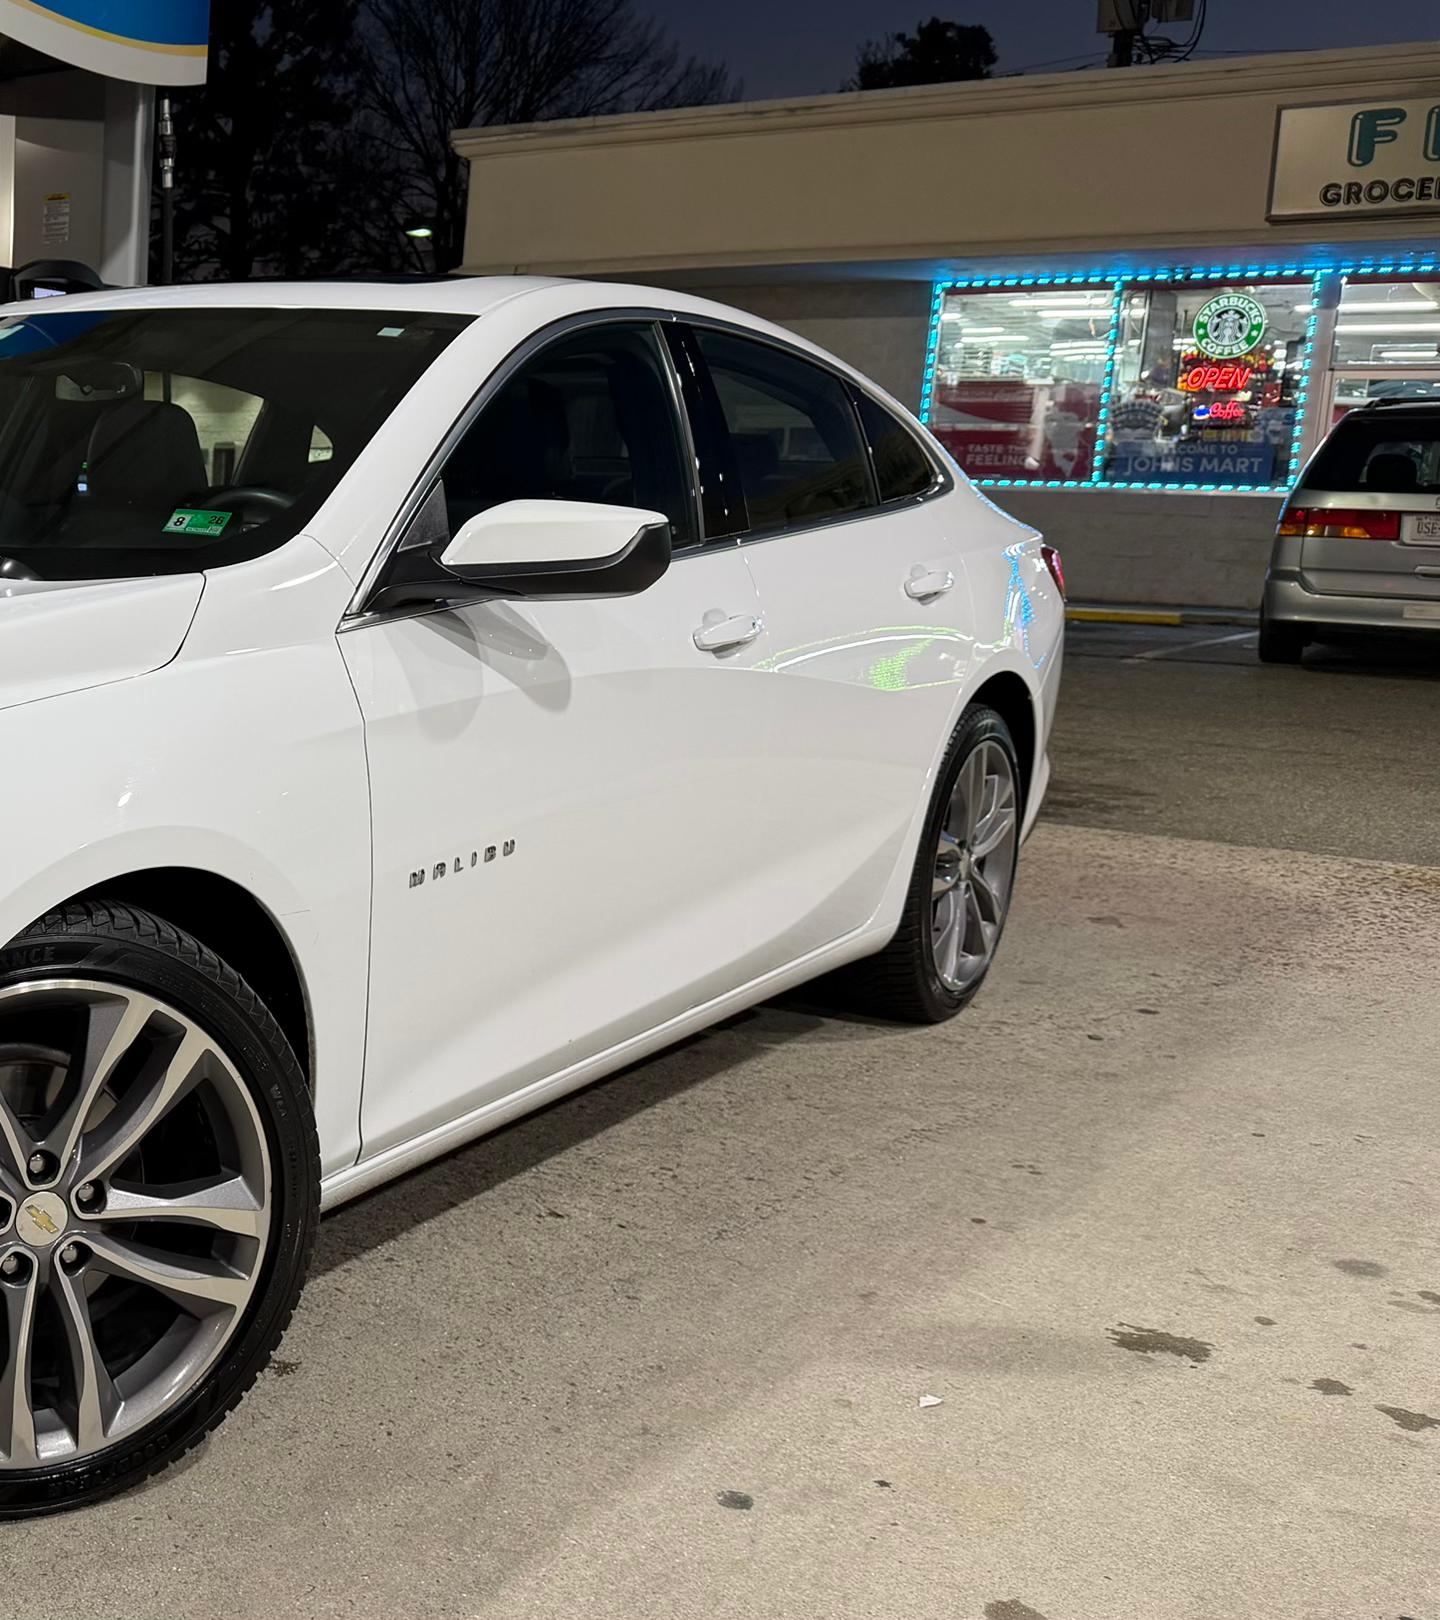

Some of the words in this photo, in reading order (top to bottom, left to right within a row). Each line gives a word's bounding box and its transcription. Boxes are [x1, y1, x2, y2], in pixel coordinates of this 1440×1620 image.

[1199, 296, 1262, 325] STARBUCKS
[1201, 338, 1249, 356] COFFEE
[1187, 367, 1251, 390] OPEN
[1209, 399, 1244, 419] Coffee
[1221, 444, 1238, 455] TO
[1199, 458, 1263, 473] MART
[173, 516, 186, 527] 8
[408, 838, 516, 889] MALIBU
